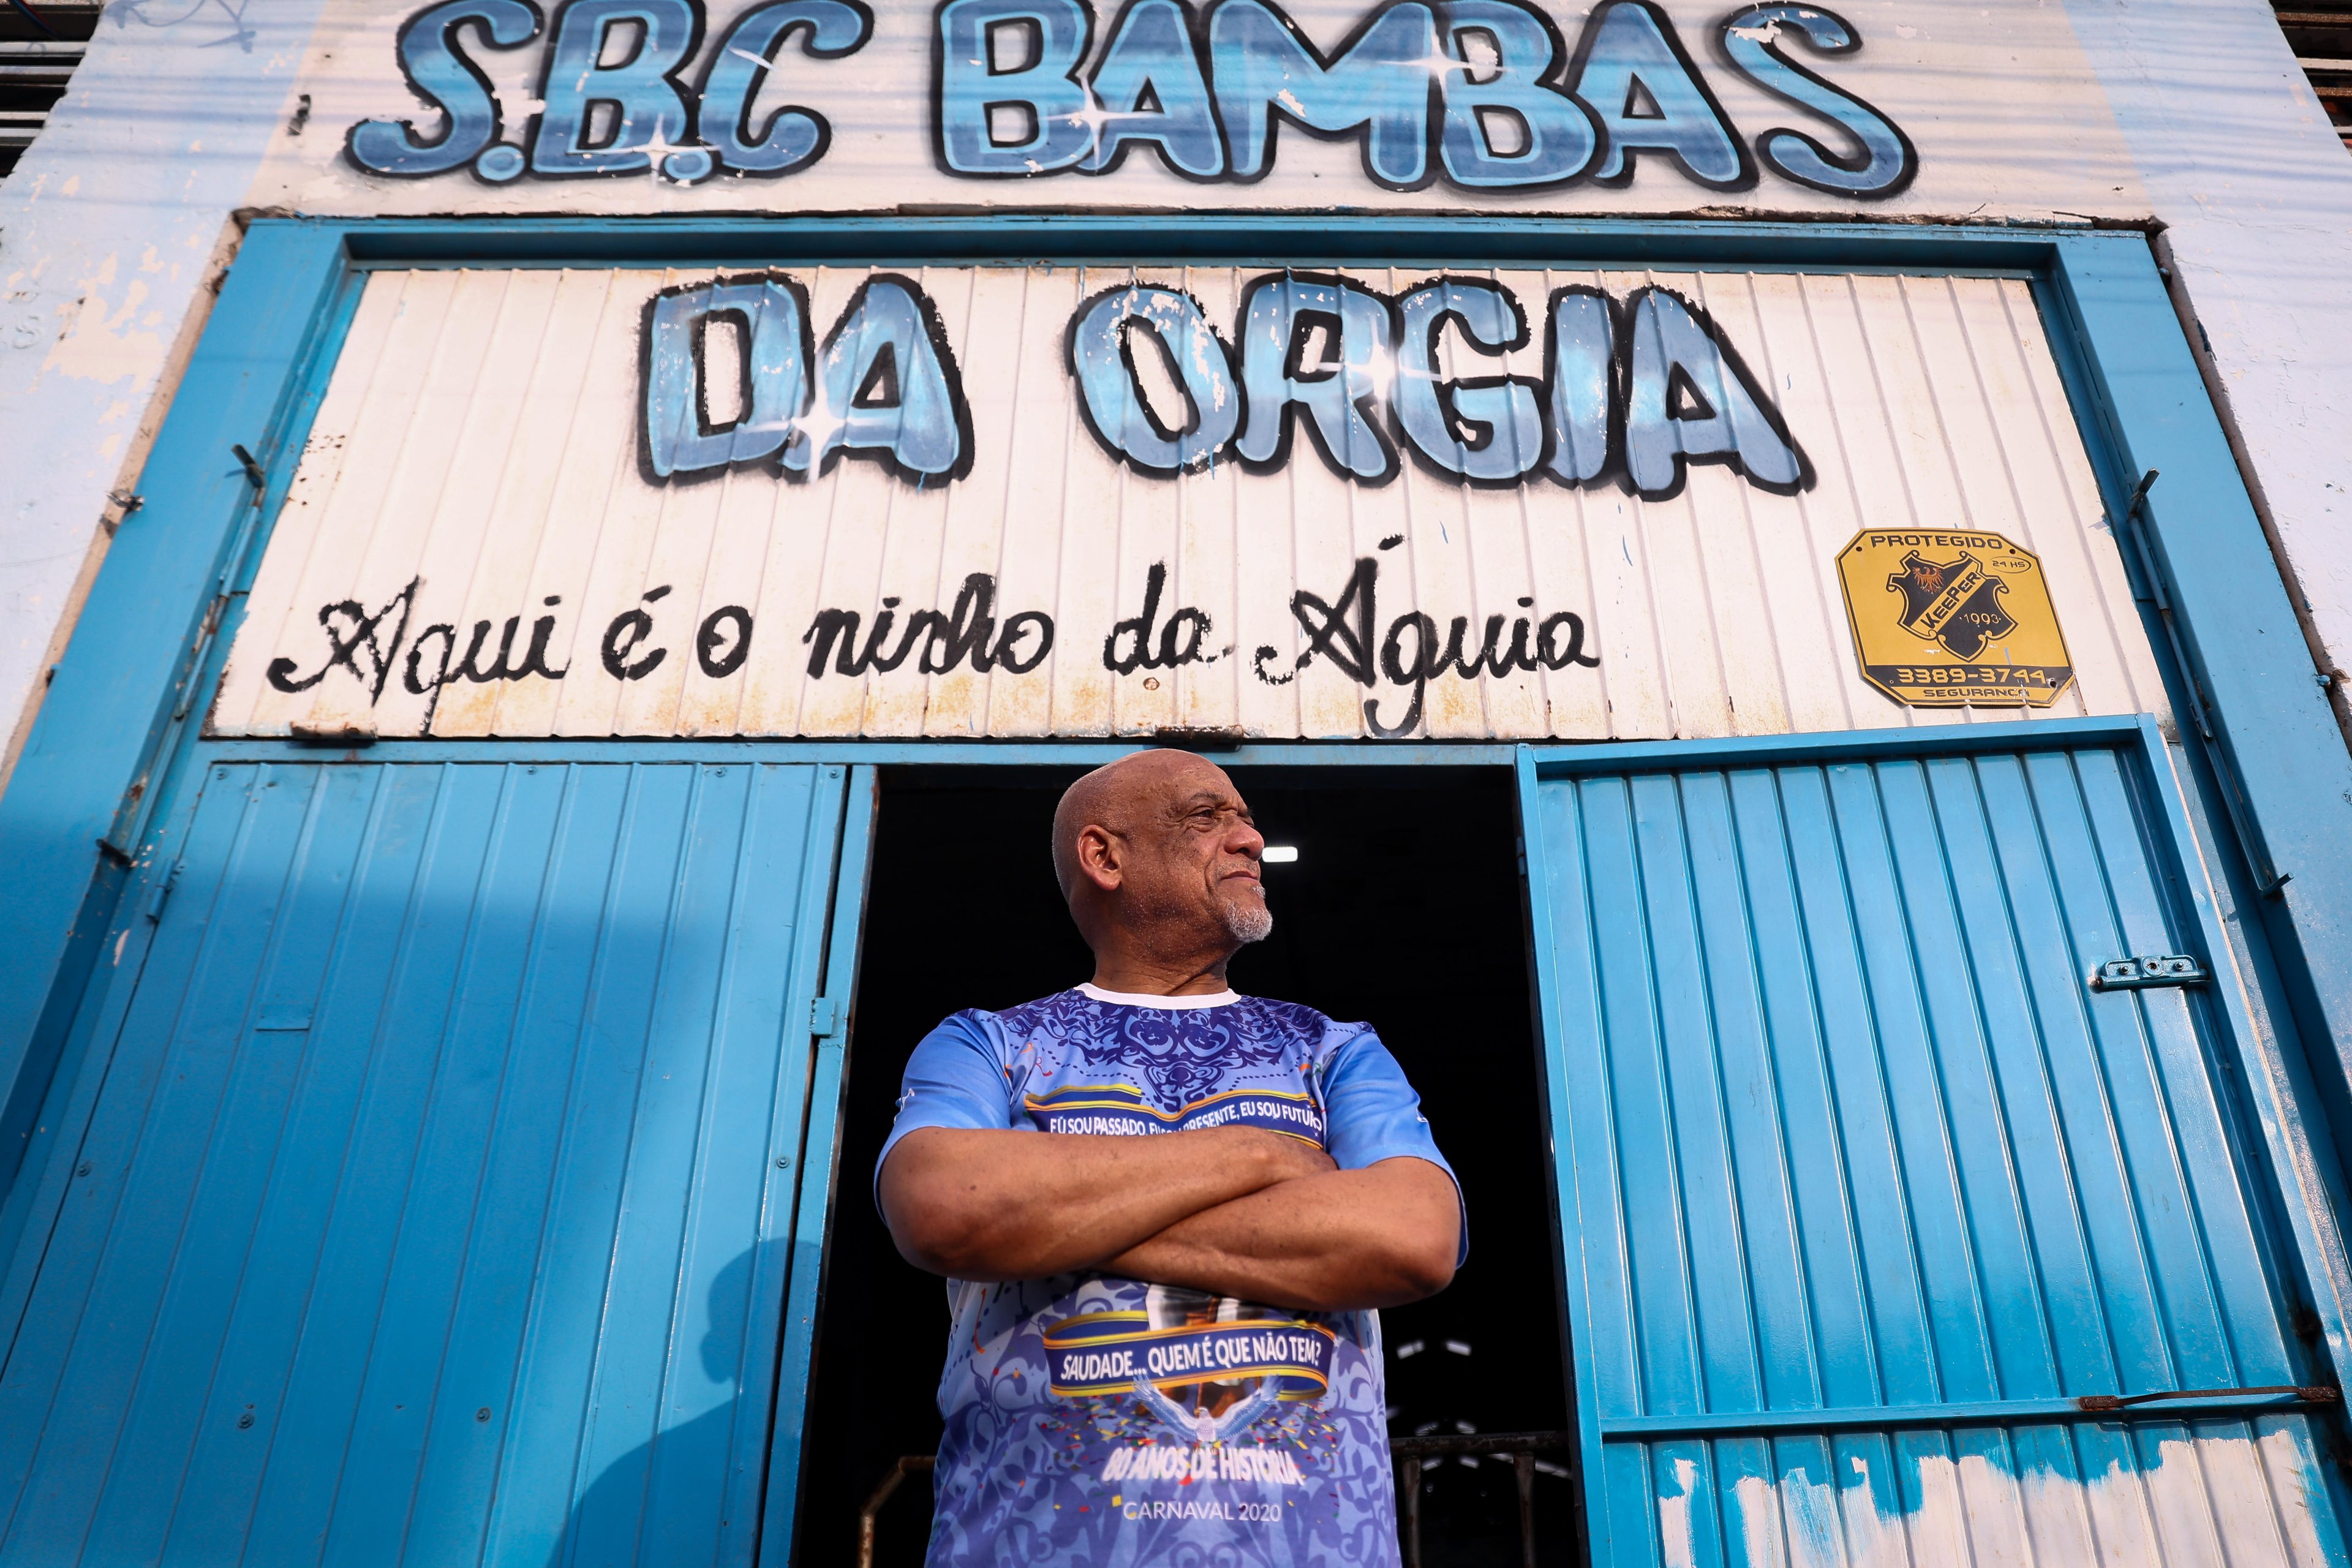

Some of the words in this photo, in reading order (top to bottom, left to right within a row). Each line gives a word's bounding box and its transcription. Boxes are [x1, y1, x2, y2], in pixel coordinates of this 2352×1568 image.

[931, 0, 1918, 199] BAMBAS
[636, 271, 975, 488] DA
[1065, 271, 1818, 501] ORGIA
[1871, 535, 2003, 550] PROTEGIDO
[1920, 571, 1981, 629] KEEPER
[266, 575, 571, 735] Aqui
[601, 584, 672, 681] é
[801, 572, 1055, 679] ninho
[1253, 533, 1601, 737] Águia
[1896, 668, 2047, 685] 3389-3744
[1068, 1117, 1092, 1134] SOU
[1240, 1101, 1256, 1117] EU
[1257, 1102, 1281, 1118] SOU
[1060, 1351, 1147, 1381] SAUDADE...
[1148, 1343, 1200, 1376] QUEM
[1202, 1336, 1215, 1368] É
[1215, 1336, 1251, 1366] QUE
[1252, 1332, 1287, 1362] NÃO
[1289, 1334, 1322, 1366] TEM?
[1127, 1447, 1189, 1480] ANOS
[1191, 1448, 1218, 1479] DE
[1219, 1442, 1304, 1486] HISTÓRIA
[1123, 1501, 1234, 1520] CARNAVAL
[1238, 1504, 1282, 1522] 2020
